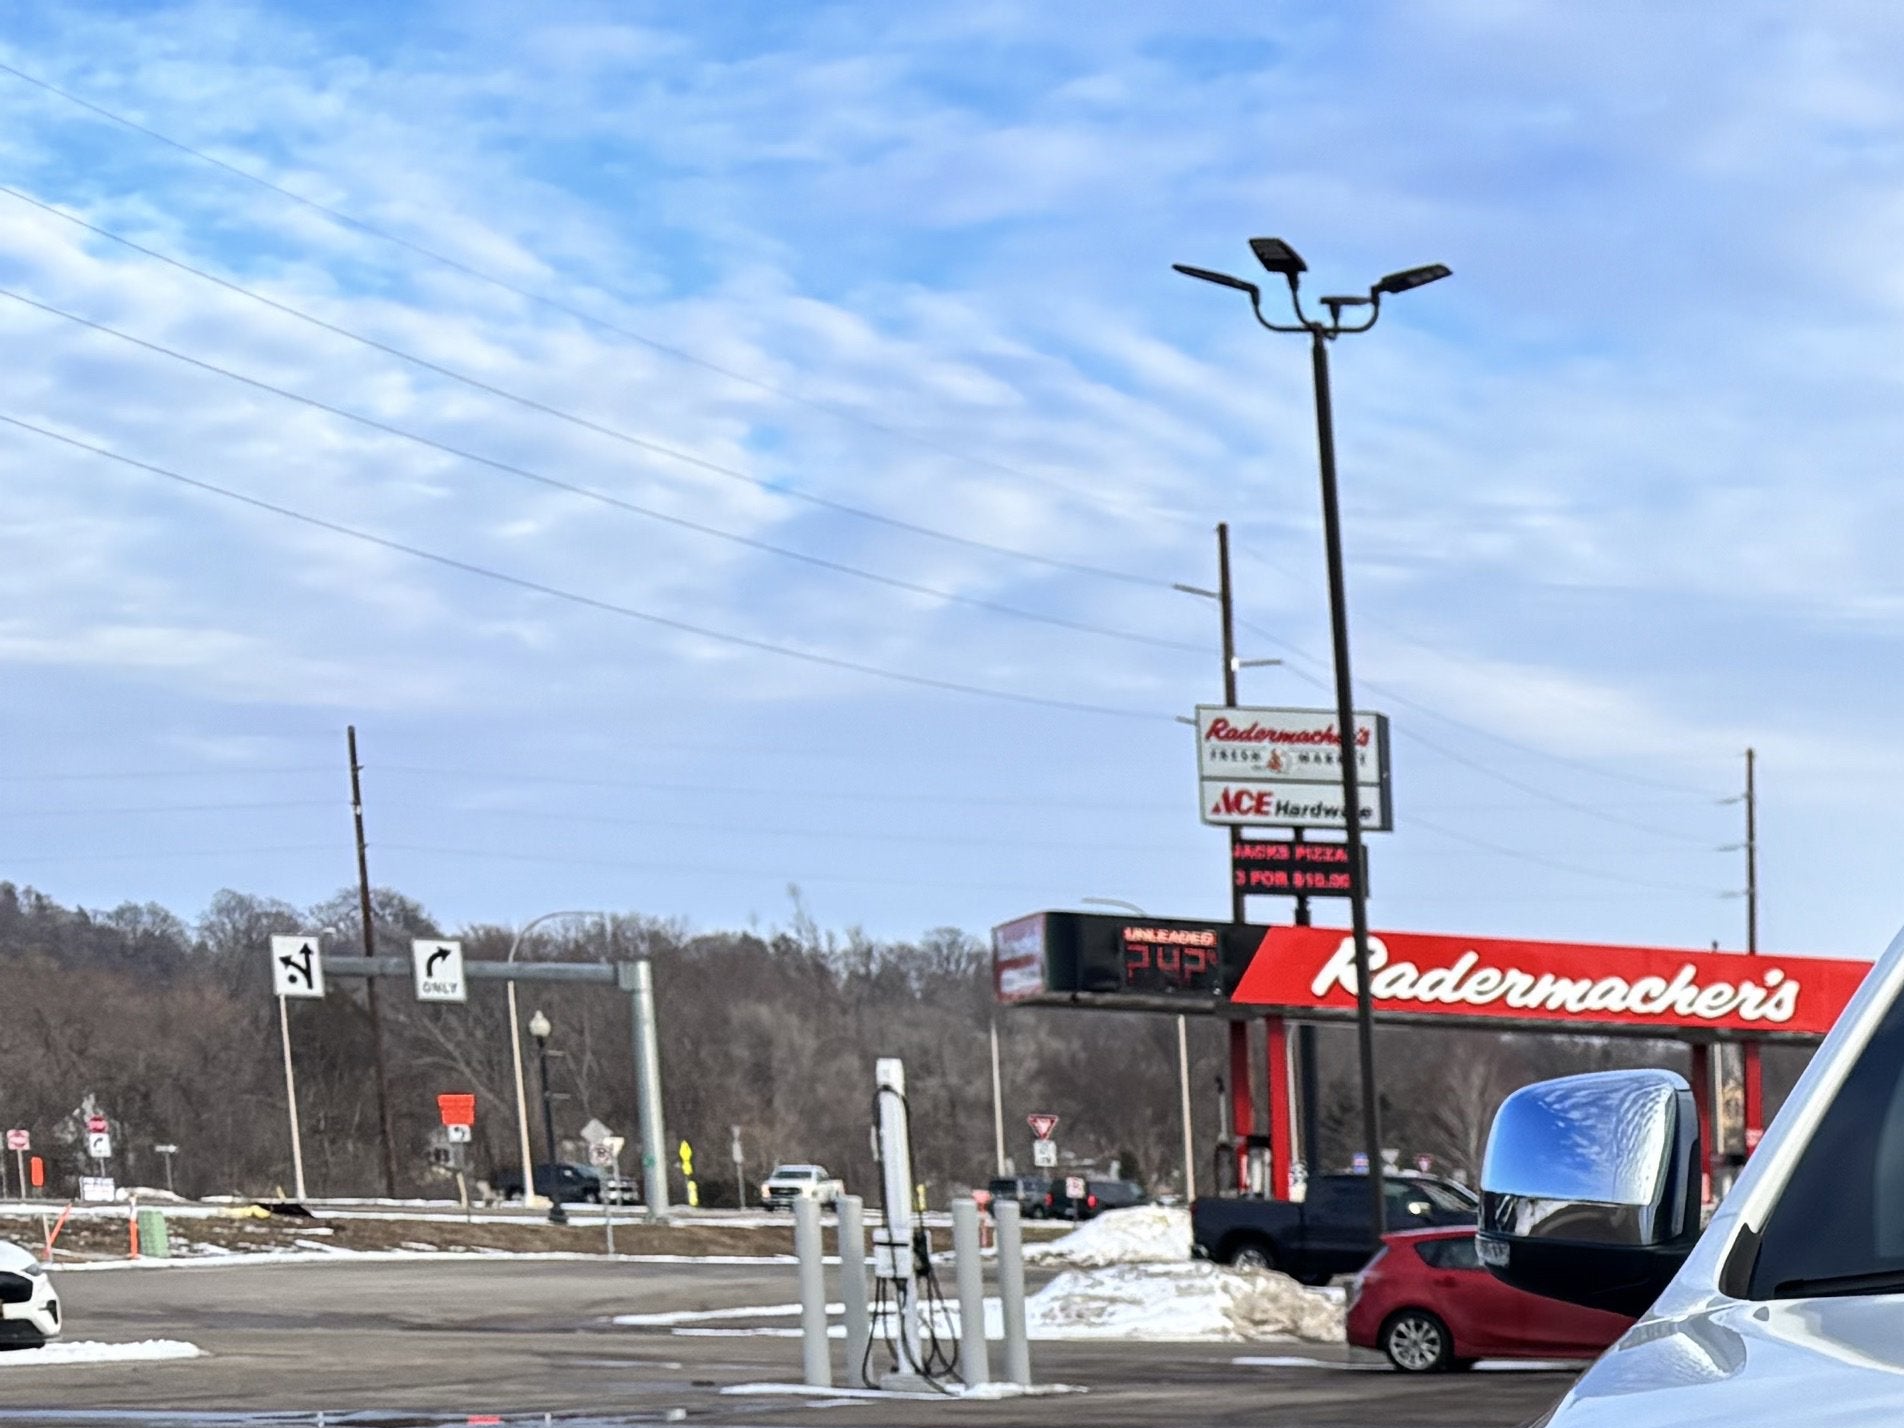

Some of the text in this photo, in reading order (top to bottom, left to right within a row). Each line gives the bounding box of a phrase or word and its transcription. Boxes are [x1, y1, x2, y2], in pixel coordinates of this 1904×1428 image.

[1205, 717, 1370, 747] Radermache's
[1211, 786, 1373, 820] ACE Hardwe
[1295, 845, 1348, 863] PIZZA
[1250, 870, 1289, 887] FOR
[1123, 926, 1217, 947] UNLEADED
[423, 981, 458, 994] ONLY
[1310, 934, 1800, 1022] Radermacher's
